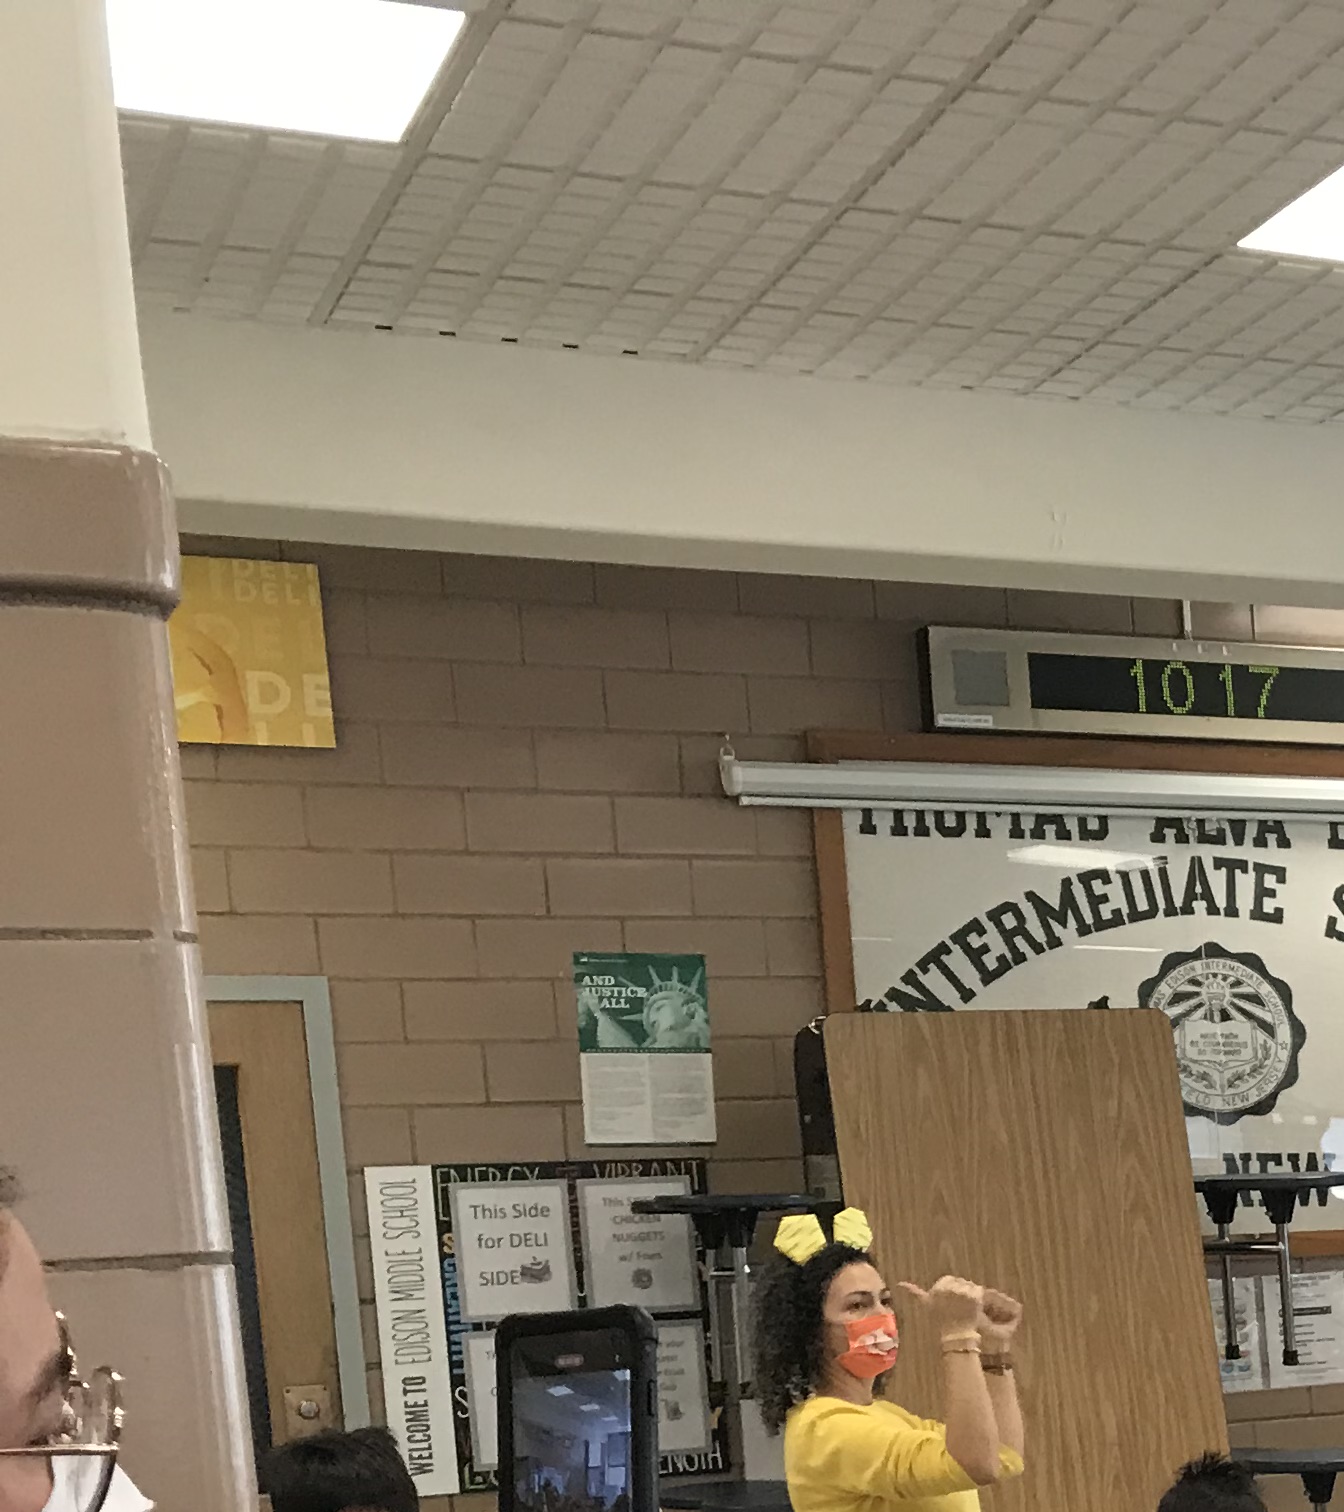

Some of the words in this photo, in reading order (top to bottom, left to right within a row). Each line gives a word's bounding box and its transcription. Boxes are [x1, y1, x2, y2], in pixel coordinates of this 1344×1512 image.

[856, 855, 1287, 1013] NTERMEDIATE
[581, 975, 615, 986] AND
[1201, 960, 1264, 989] INTERMEDIATE
[582, 987, 647, 998] JUSTICE
[600, 998, 630, 1009] ALL
[1223, 1094, 1250, 1106] NEW
[379, 1177, 421, 1240] SCHOOL
[469, 1203, 507, 1220] This
[511, 1202, 551, 1219] Side
[477, 1233, 504, 1249] for
[509, 1232, 549, 1249] DELI
[384, 1246, 425, 1302] MIDDLE
[479, 1270, 521, 1287] SIDE
[390, 1308, 432, 1366] EDISON
[402, 1375, 427, 1397] TO
[402, 1399, 434, 1477] WELCOME
